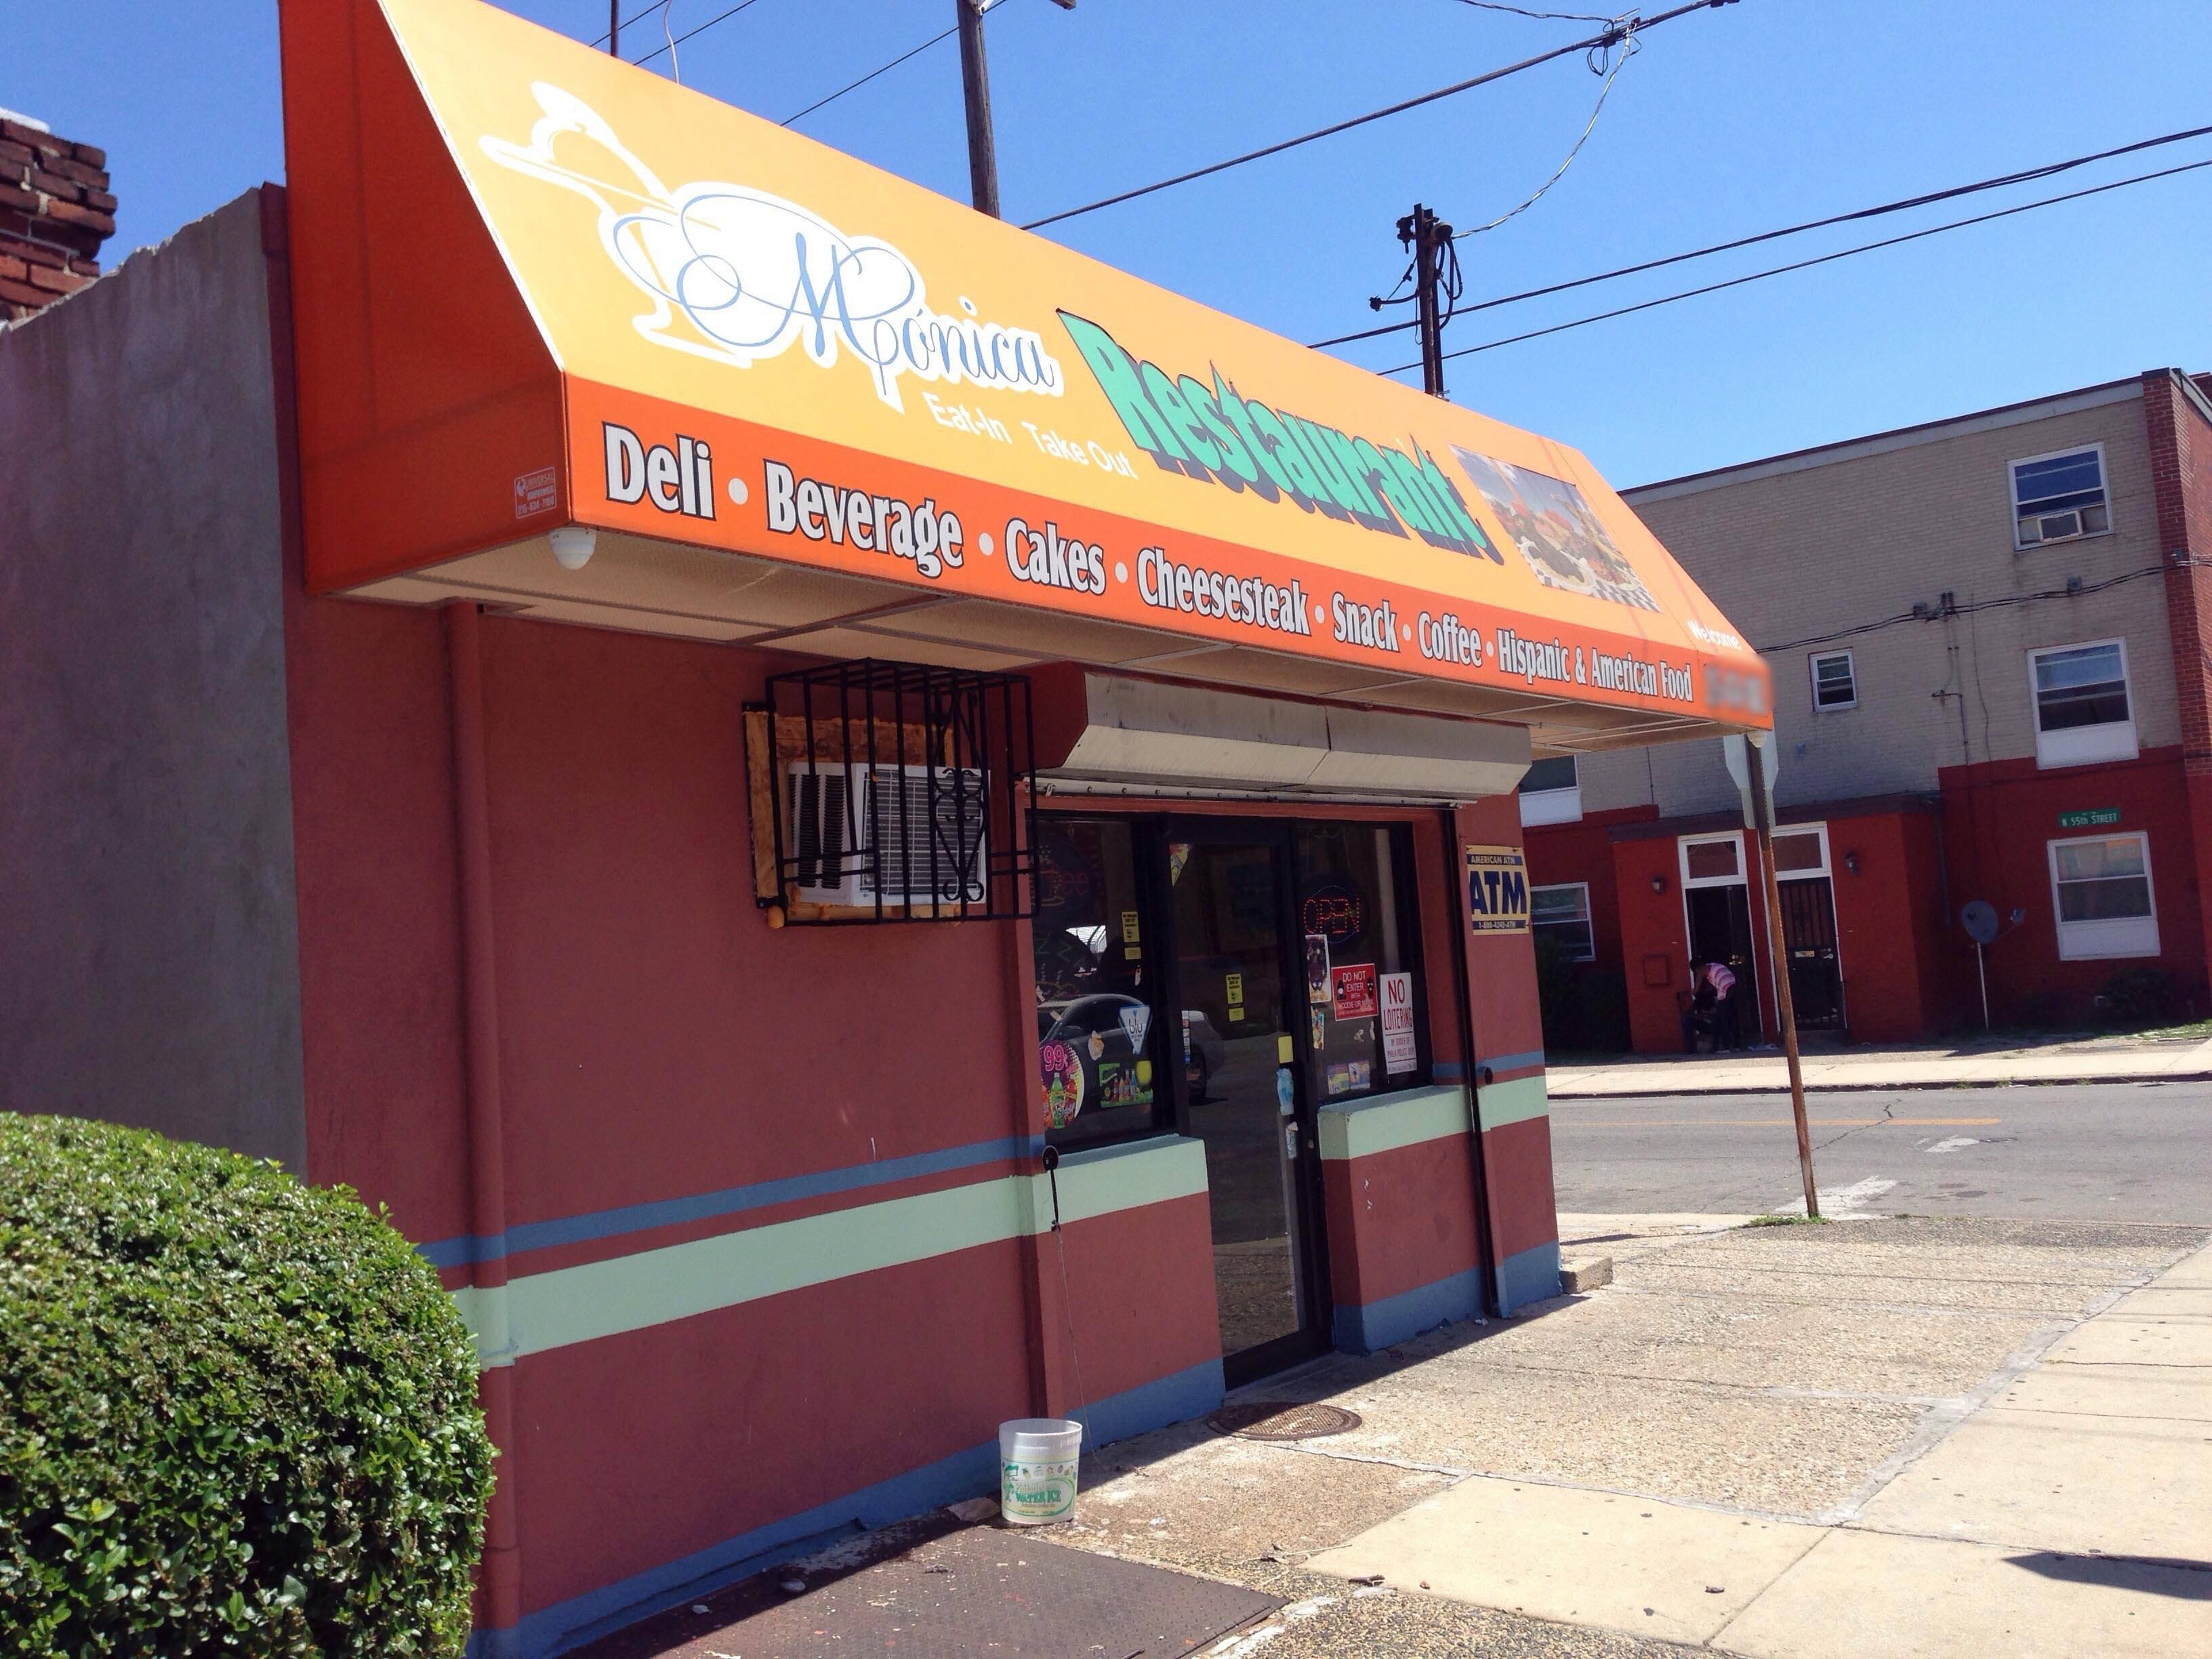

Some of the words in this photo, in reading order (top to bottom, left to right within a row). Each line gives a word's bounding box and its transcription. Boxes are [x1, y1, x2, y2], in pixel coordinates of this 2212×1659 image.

[921, 391, 1012, 445] Eat-In
[1021, 421, 1089, 466] Take
[1087, 440, 1139, 480] Out
[1056, 307, 1504, 567] Restaurant
[602, 421, 716, 521] Deli
[762, 457, 964, 579] Beverage
[1005, 517, 1106, 596] Cakes
[1136, 546, 1312, 636] Cheesesteak
[1331, 591, 1400, 653] Snack
[1418, 611, 1482, 668] Coffee
[1496, 628, 1571, 684] Hispanic
[1574, 646, 1588, 685] &
[1591, 647, 1658, 696] American
[1660, 661, 1694, 702] Food
[1687, 619, 1742, 651] Welcome
[2091, 813, 2117, 824] STREET
[1471, 855, 1502, 864] AMERICAN
[1469, 871, 1527, 914] ATM
[1303, 896, 1360, 934] OPEN
[1343, 972, 1352, 982] DO
[1353, 970, 1366, 981] NOT
[1347, 983, 1364, 992] ENTER
[1388, 979, 1405, 1004] NO
[1128, 1018, 1143, 1034] blu
[1383, 1007, 1412, 1031] LOITERING
[1047, 1490, 1061, 1503] ICE
